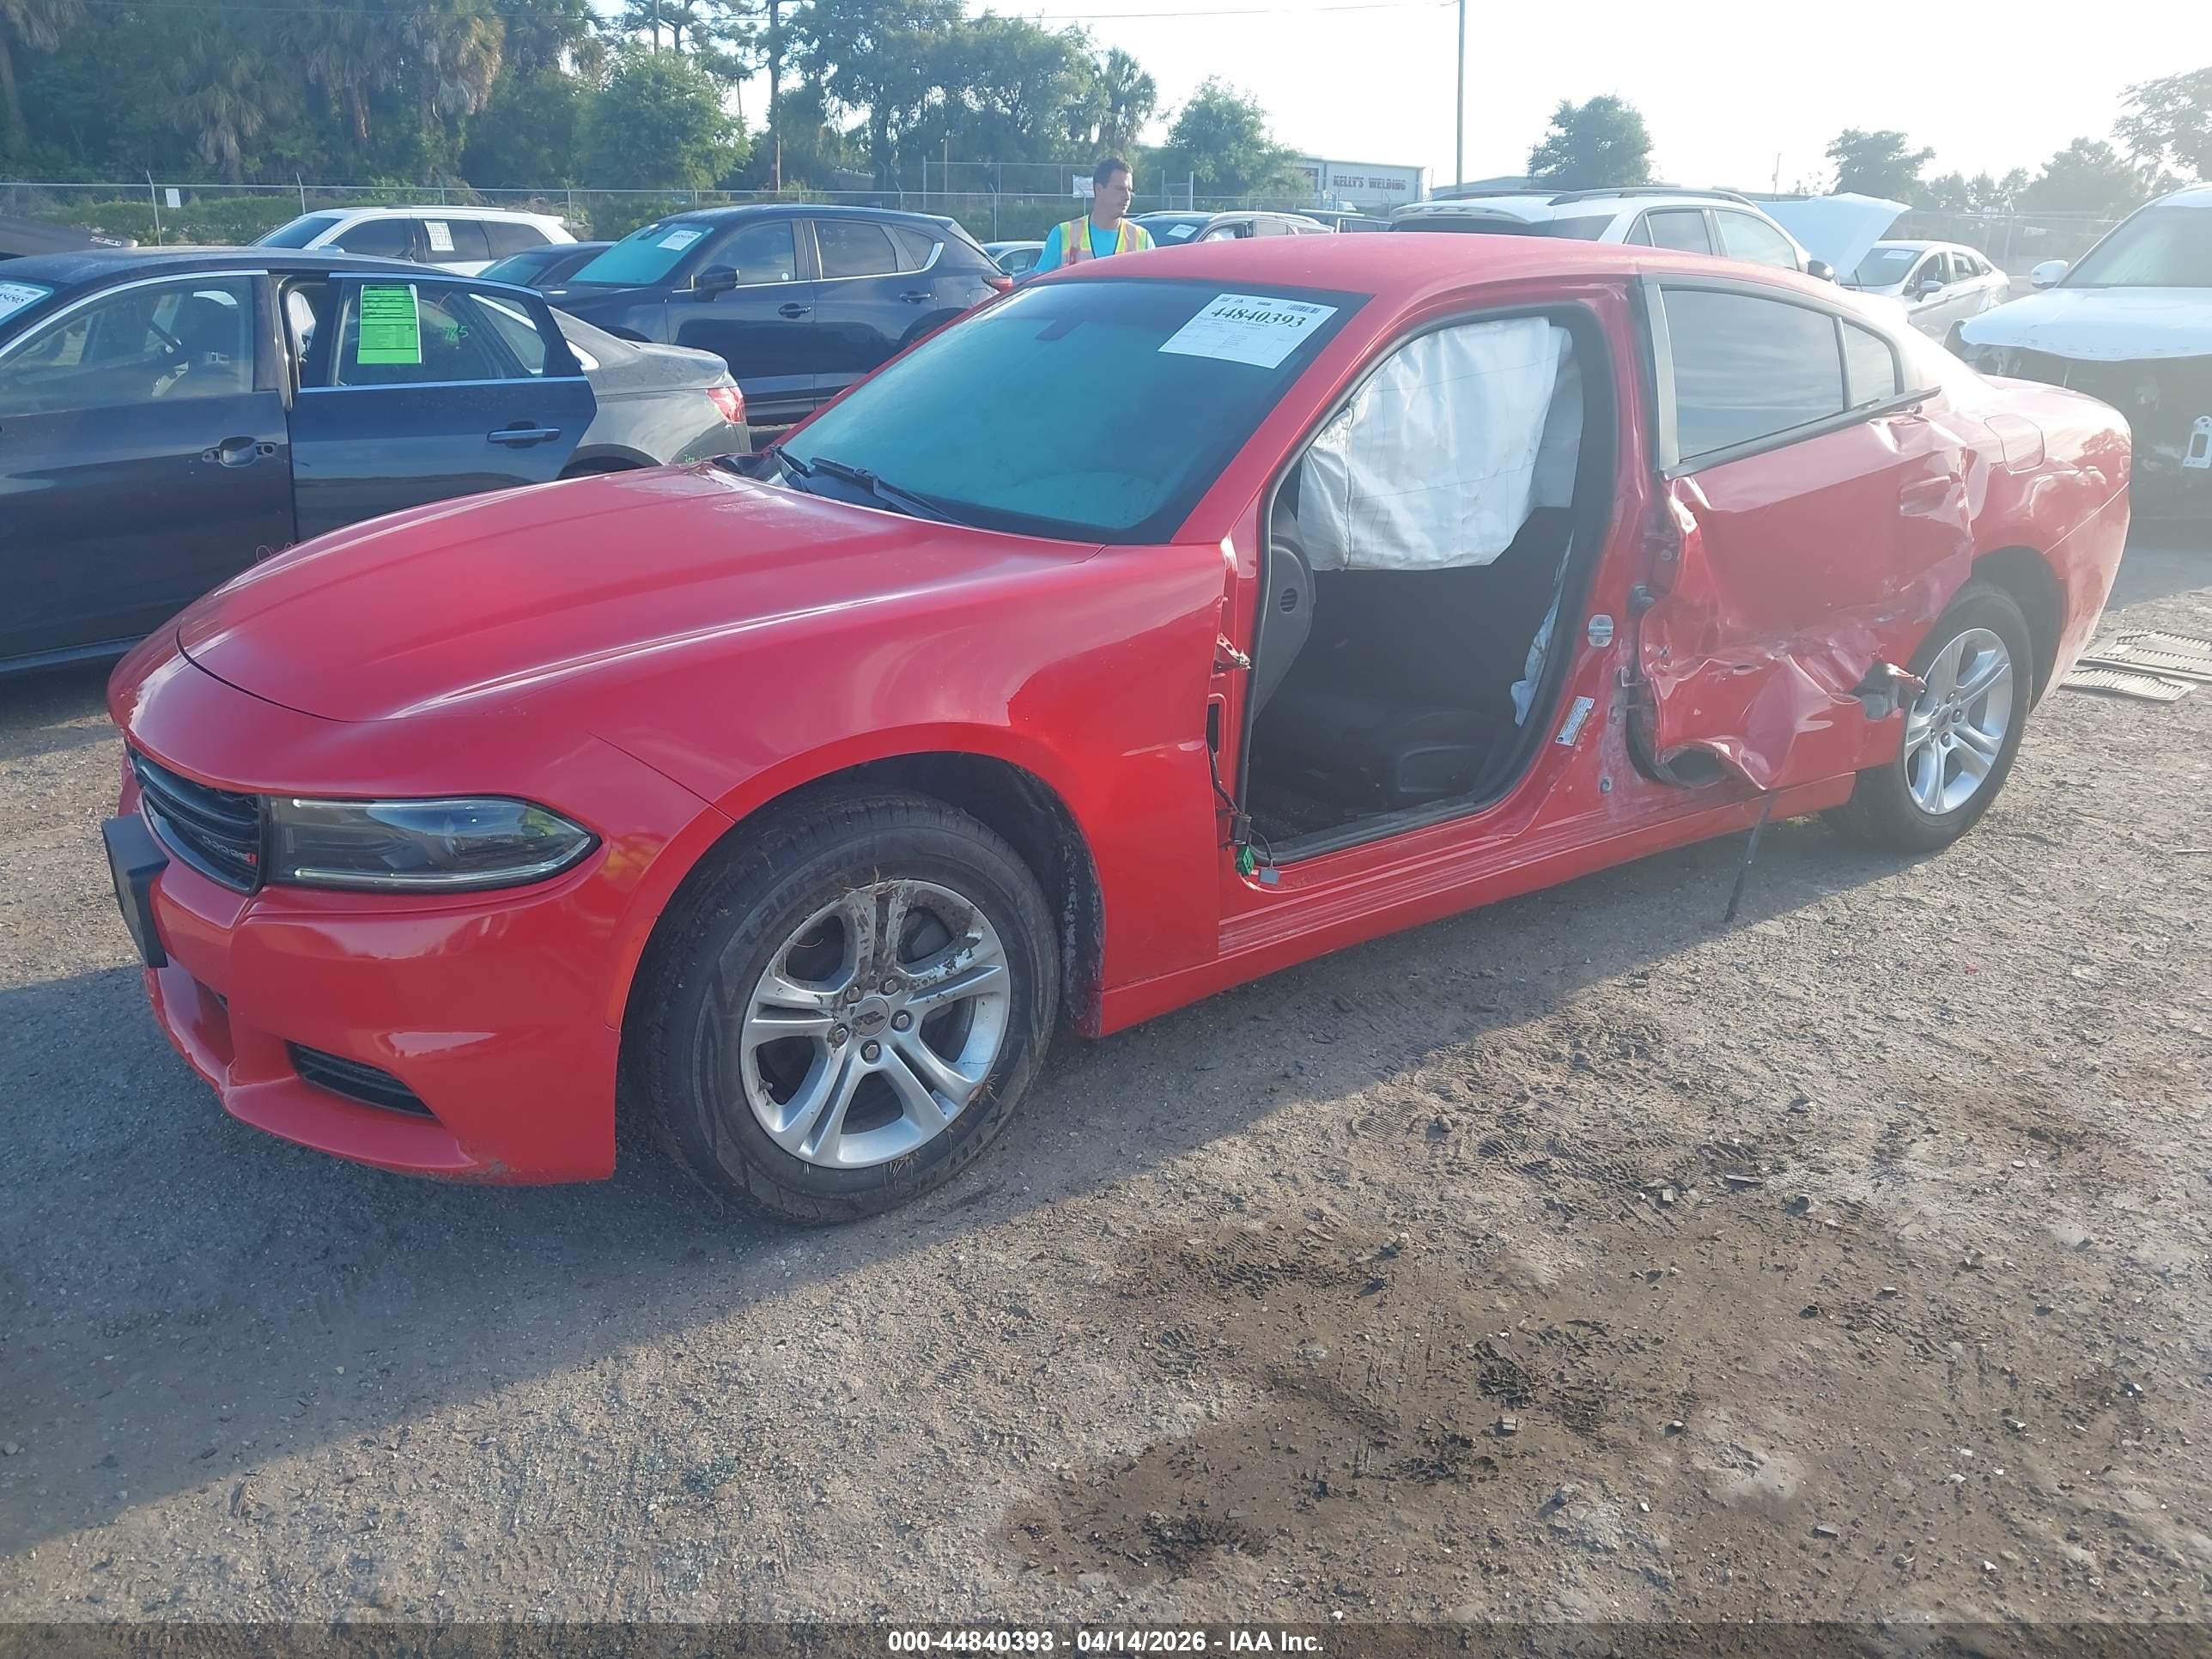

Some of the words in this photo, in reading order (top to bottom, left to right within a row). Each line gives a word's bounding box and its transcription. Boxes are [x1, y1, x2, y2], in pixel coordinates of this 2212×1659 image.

[1334, 175, 1364, 188] KELLY'S
[1369, 178, 1407, 190] WELDING
[1211, 307, 1306, 327] 44840393
